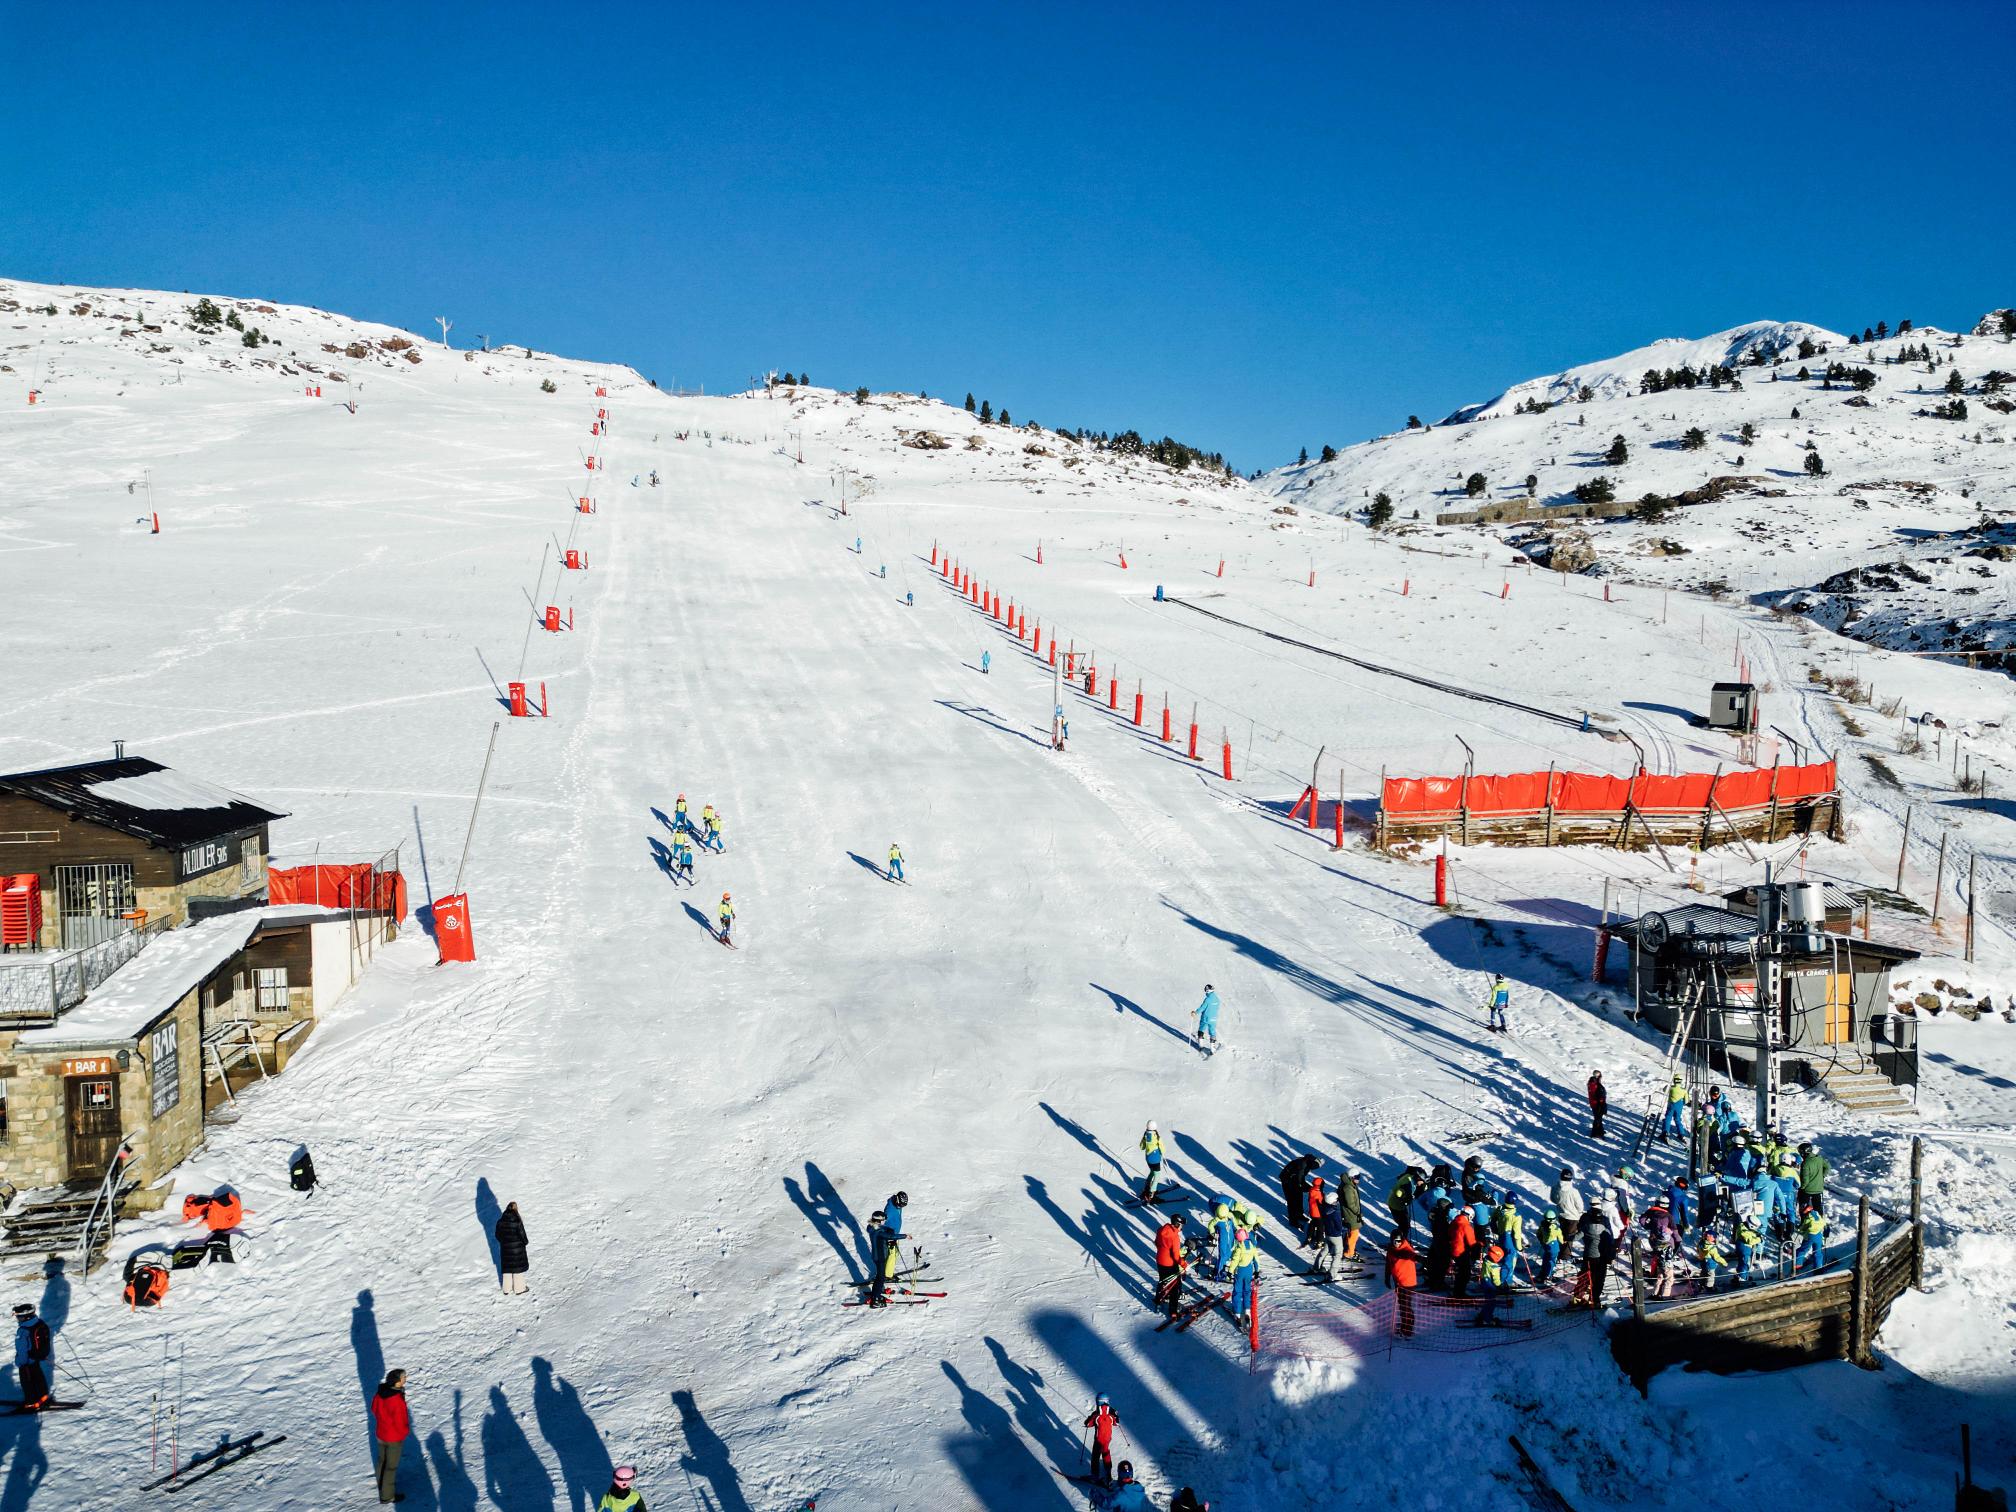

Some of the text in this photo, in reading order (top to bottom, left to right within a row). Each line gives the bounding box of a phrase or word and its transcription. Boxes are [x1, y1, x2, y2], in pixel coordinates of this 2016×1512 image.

[182, 843, 216, 876] ALQUILER
[152, 1022, 177, 1063] BAR
[75, 1060, 97, 1074] BAR
